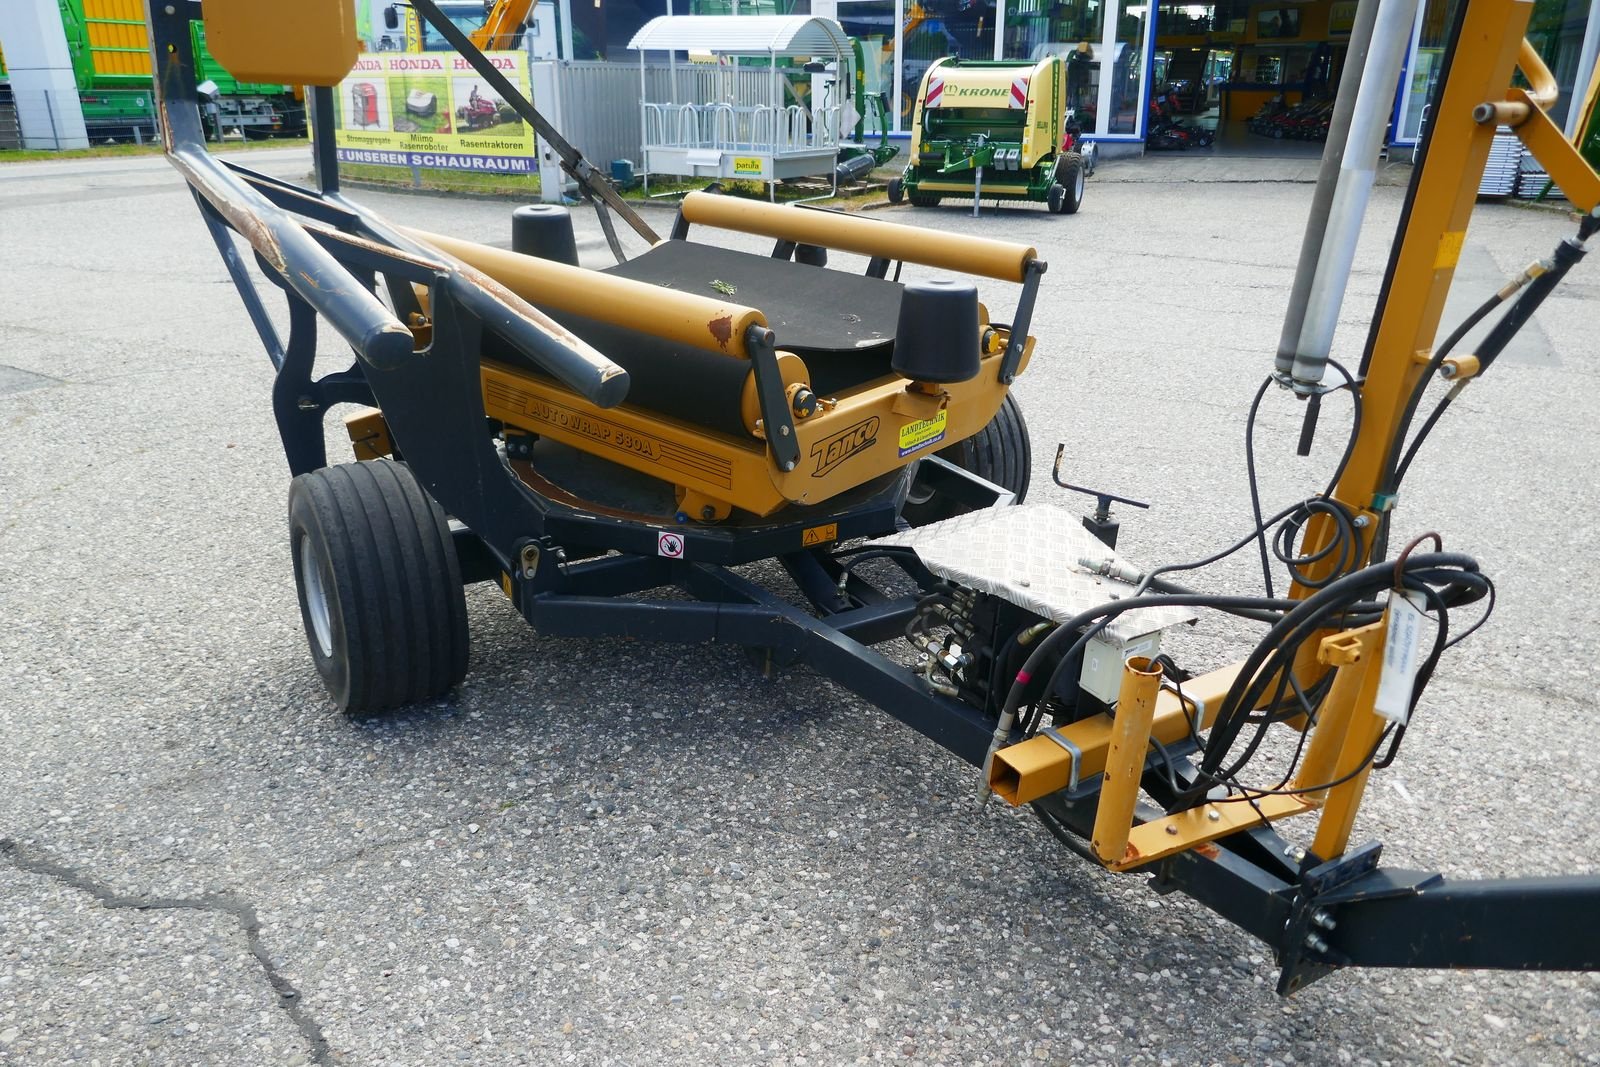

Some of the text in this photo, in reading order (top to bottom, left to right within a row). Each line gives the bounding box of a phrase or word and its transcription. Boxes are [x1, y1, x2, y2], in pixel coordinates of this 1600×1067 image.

[352, 60, 382, 71] ONDA
[390, 58, 443, 70] HONDA
[454, 58, 515, 70] HODA
[958, 88, 1010, 97] KRONE
[399, 141, 448, 151] Rasenroboter
[460, 139, 524, 150] Rasentraktoren
[347, 151, 407, 165] UNSEREN
[412, 154, 530, 171] SCHAURAUM!
[736, 161, 759, 170] patura
[531, 400, 653, 456] AUTOWRAP 580A
[810, 415, 880, 477] Tanco
